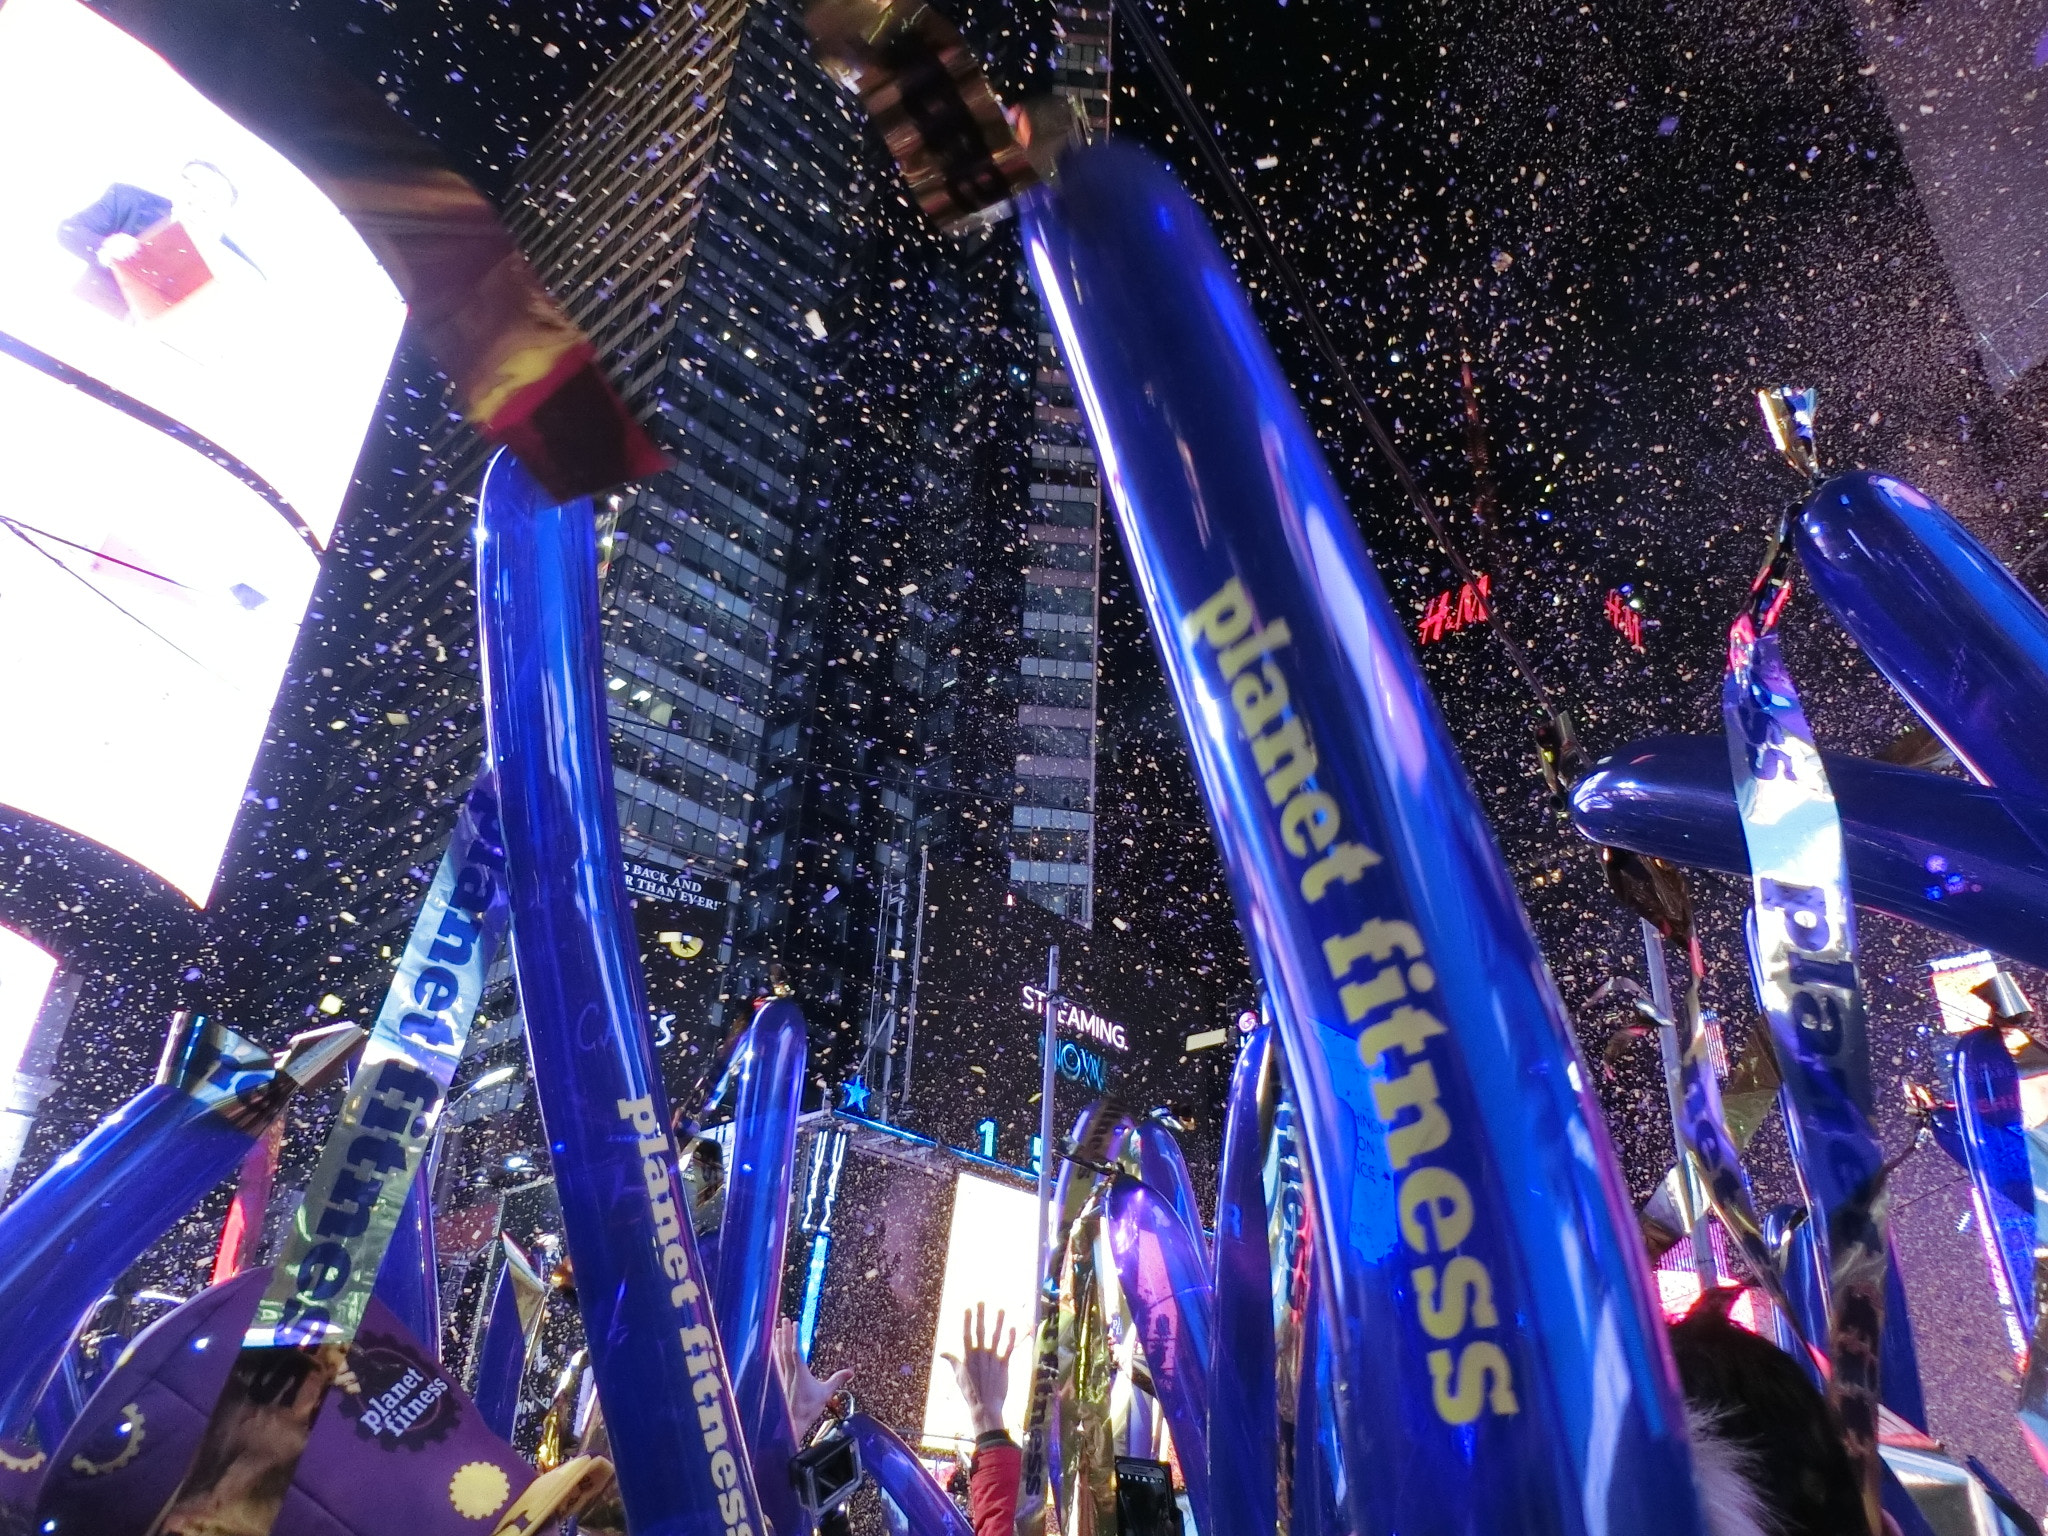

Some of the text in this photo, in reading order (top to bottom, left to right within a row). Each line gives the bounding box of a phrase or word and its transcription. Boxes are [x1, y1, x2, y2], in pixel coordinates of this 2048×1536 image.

[1418, 574, 1490, 645] H&M
[632, 864, 670, 884] BACK
[671, 877, 702, 893] AND
[636, 878, 677, 899] THAN
[679, 891, 719, 911] EVER!
[400, 788, 507, 1047] planet
[1022, 985, 1130, 1051] STEAMING.
[1182, 577, 1521, 1427] planet fitness
[616, 1093, 701, 1308] planet
[360, 1366, 424, 1436] planet
[384, 1377, 449, 1437] fitness
